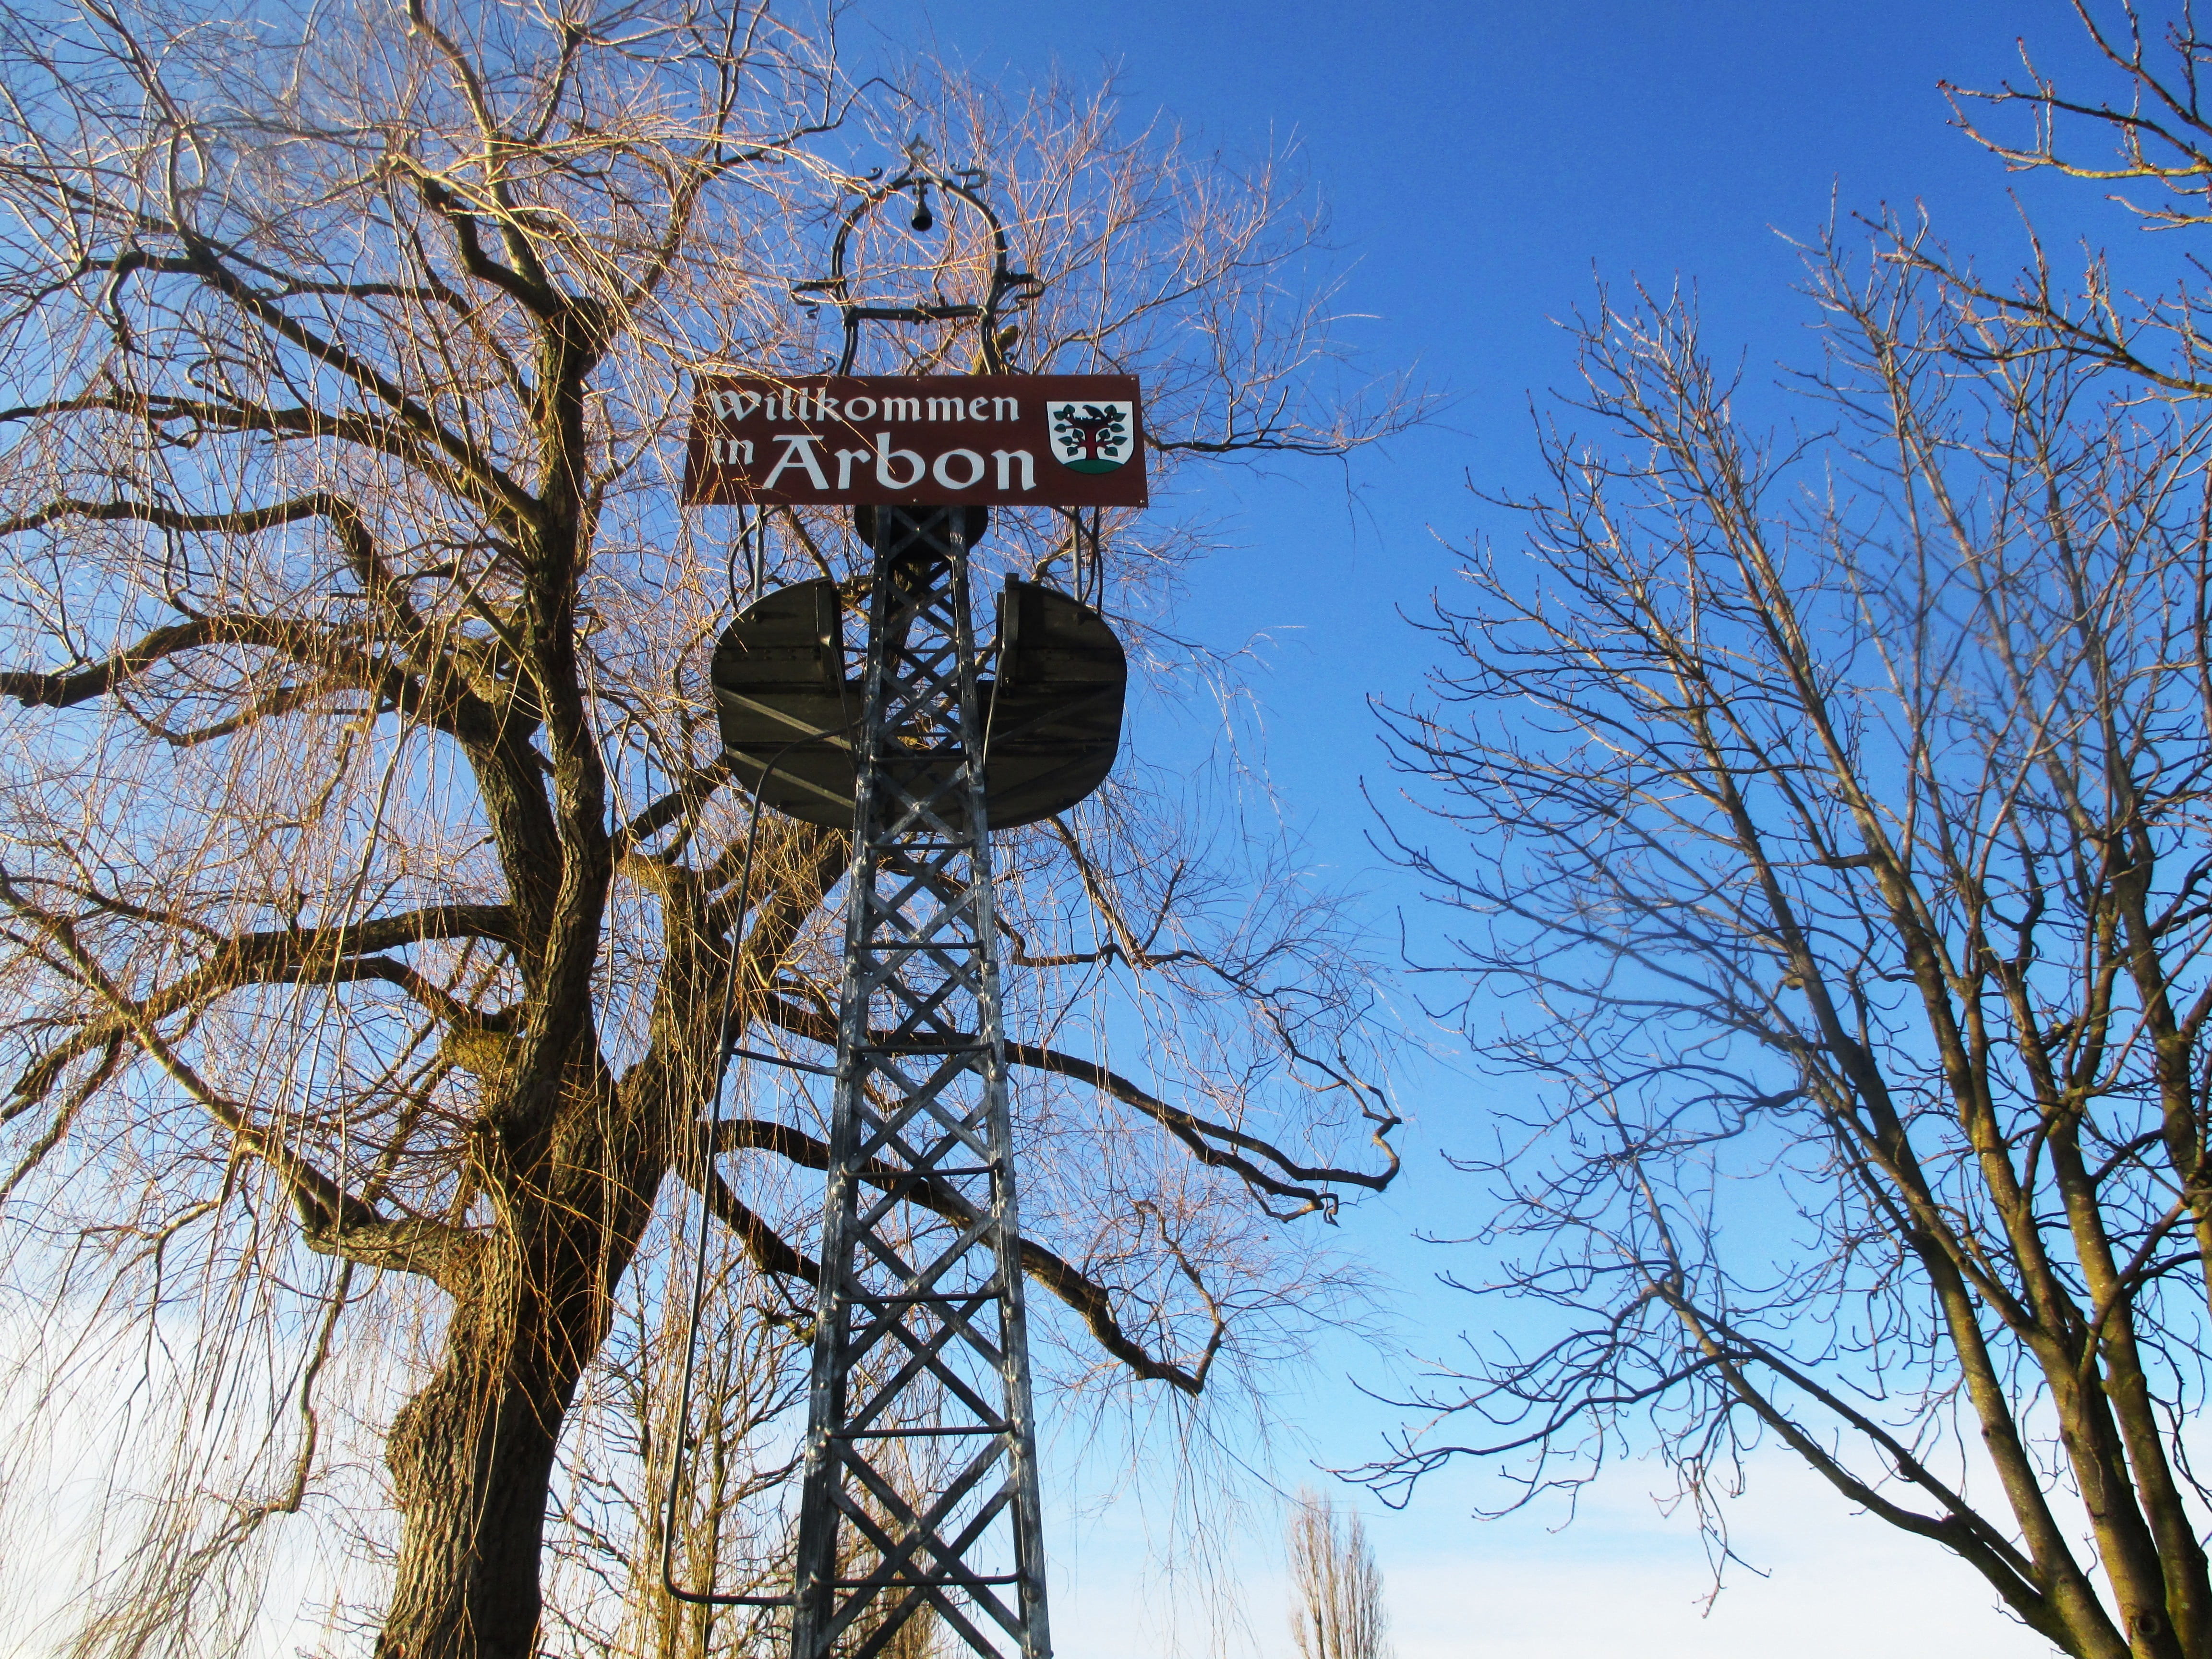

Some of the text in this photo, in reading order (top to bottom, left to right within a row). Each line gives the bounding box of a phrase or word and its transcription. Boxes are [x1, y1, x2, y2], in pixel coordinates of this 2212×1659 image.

[708, 387, 1020, 421] Willkommen
[711, 432, 1037, 491] in Arbon
